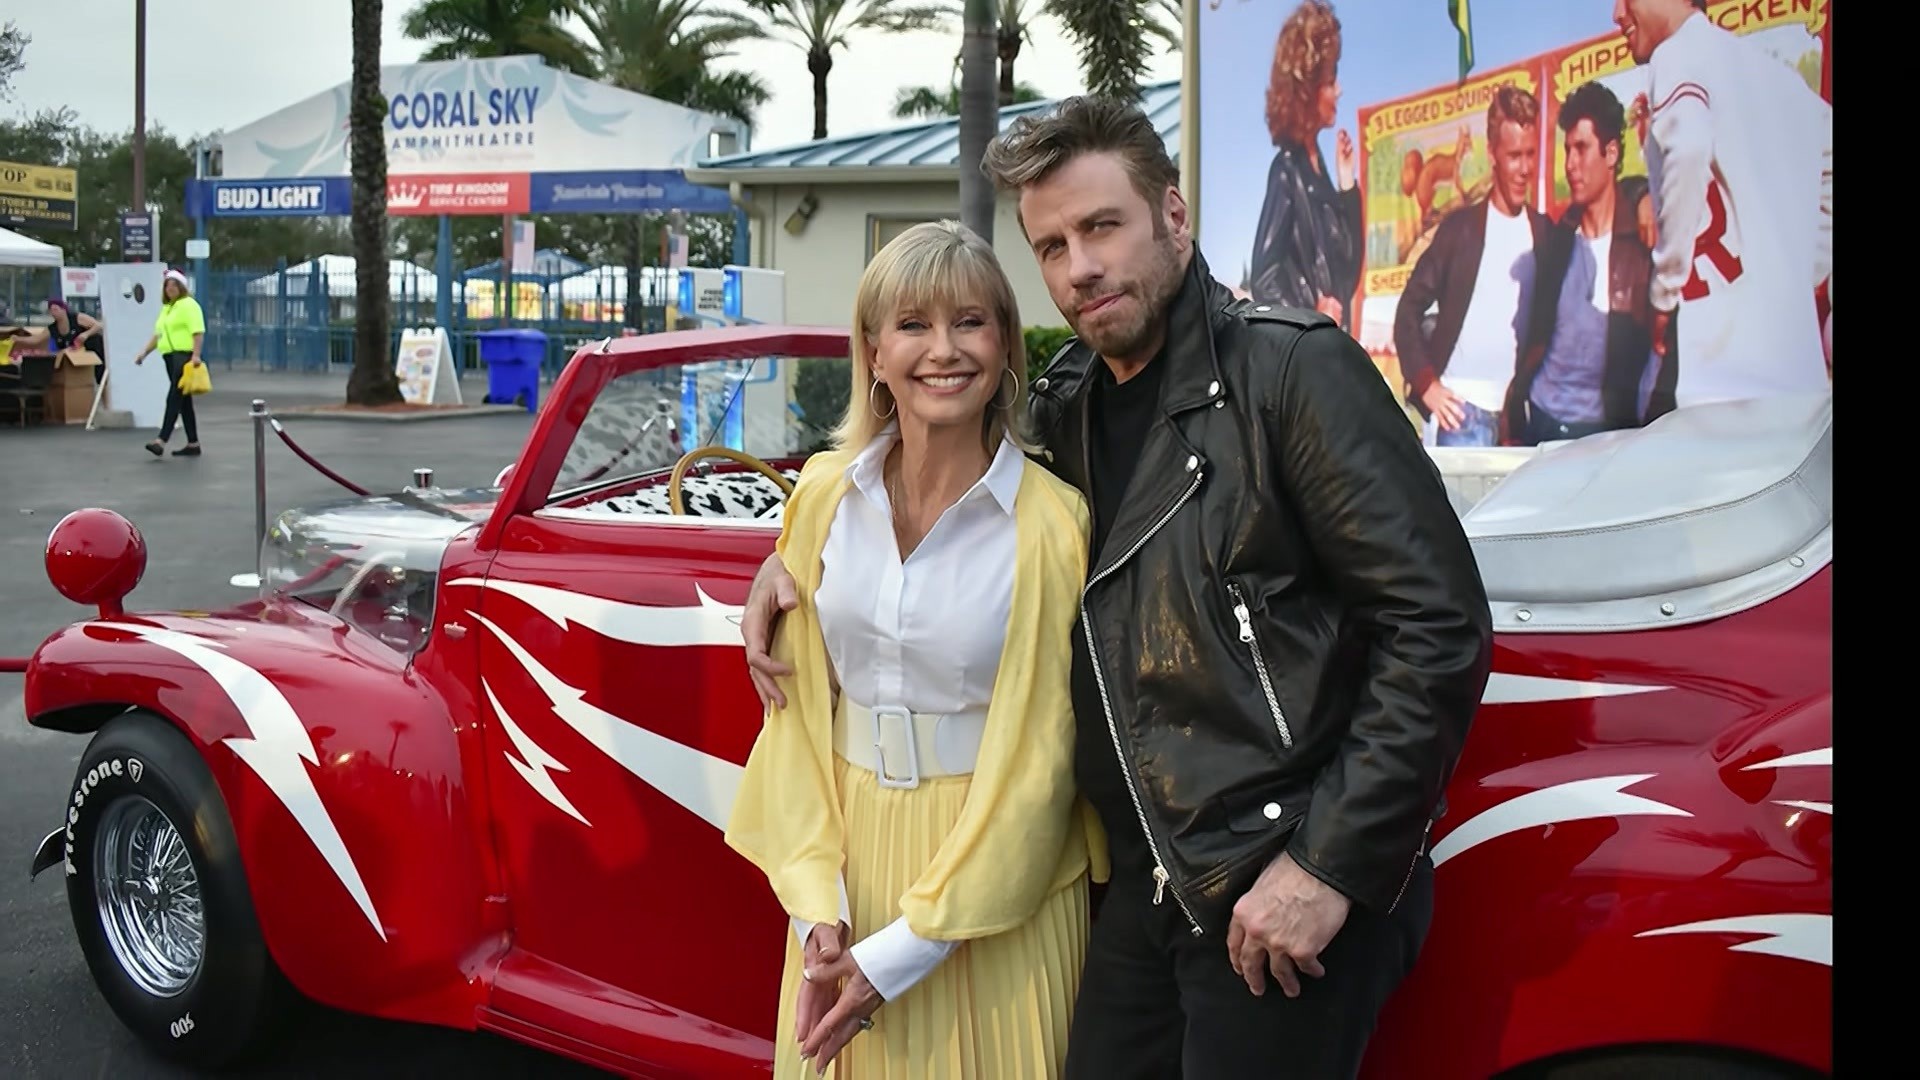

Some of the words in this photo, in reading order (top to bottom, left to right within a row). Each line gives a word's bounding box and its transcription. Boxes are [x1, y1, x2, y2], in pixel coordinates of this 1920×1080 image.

[390, 90, 480, 130] CORAL
[488, 86, 539, 126] SKY
[1386, 100, 1440, 131] LEGGED
[392, 131, 534, 149] AMPHITHEATRE
[0, 168, 27, 183] OP
[217, 187, 260, 209] BUD
[261, 185, 322, 208] LIGHT
[429, 183, 454, 195] TIRE
[455, 181, 510, 195] KINGDOM
[429, 196, 466, 207] SERVICE
[467, 195, 509, 207] CENTERS
[65, 758, 123, 877] Firestone
[170, 1011, 195, 1039] 500
